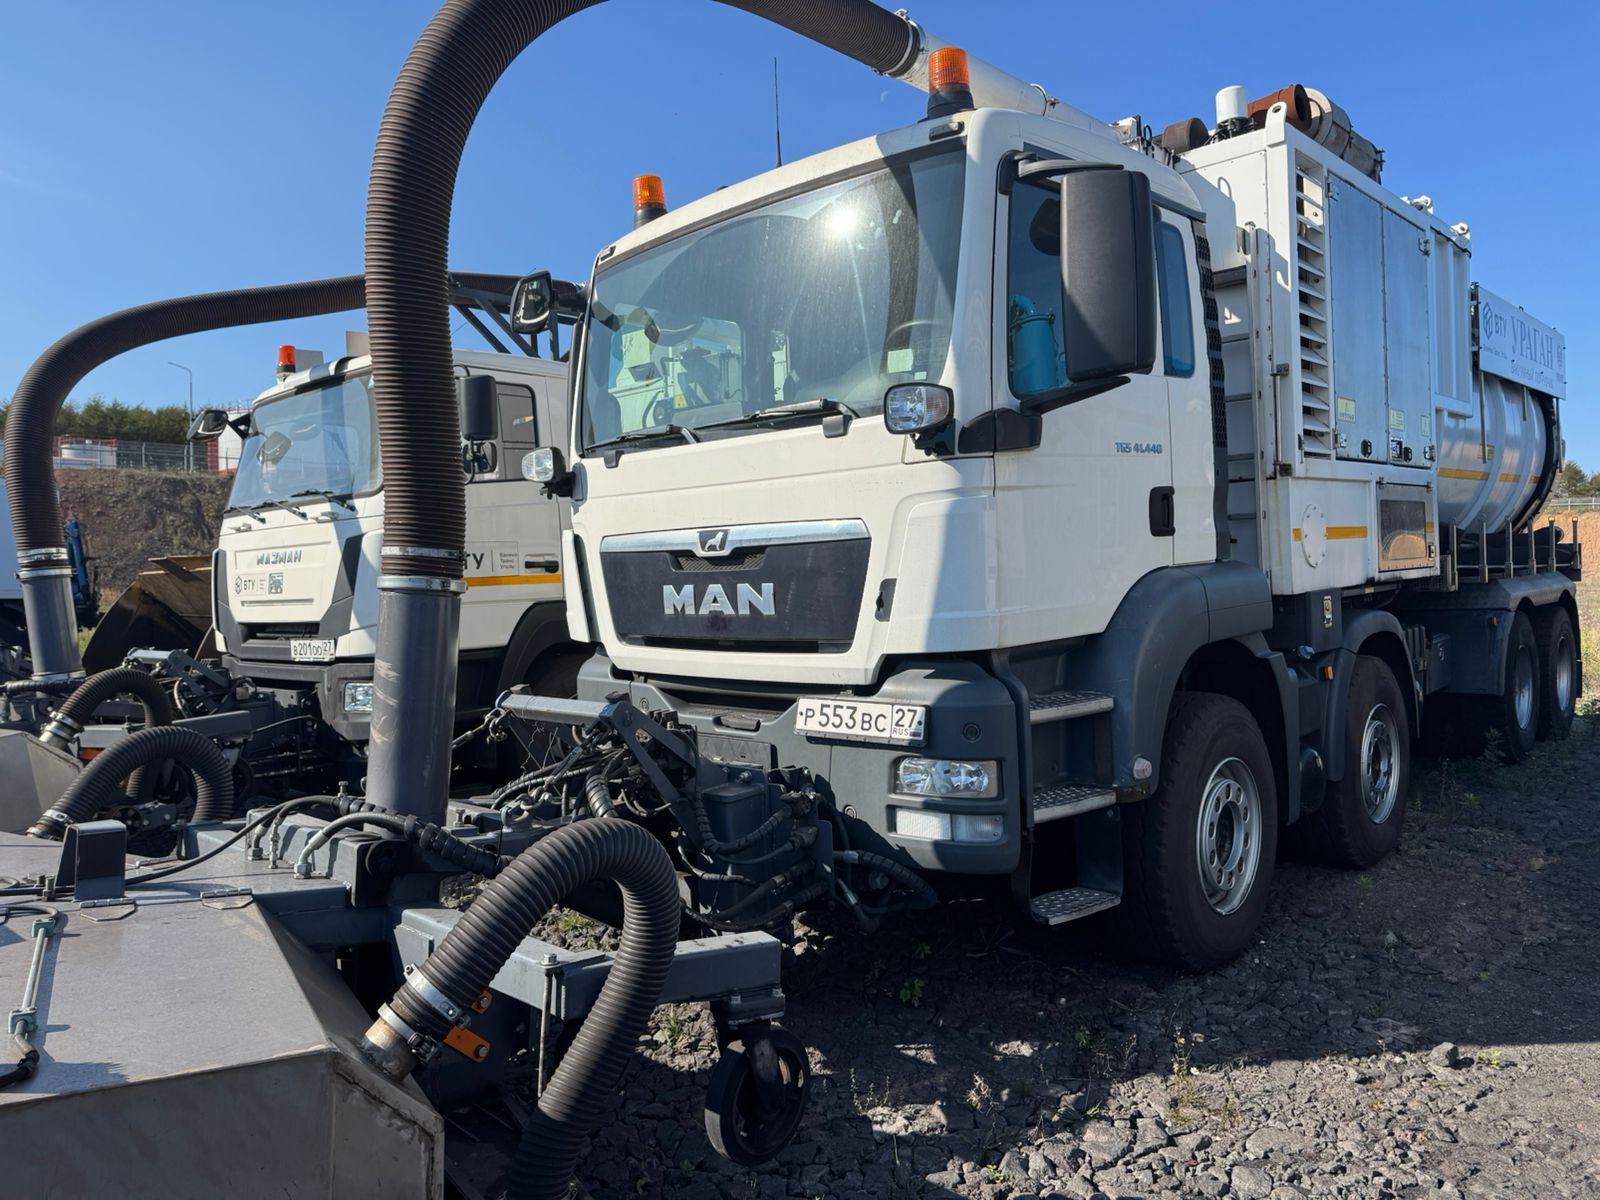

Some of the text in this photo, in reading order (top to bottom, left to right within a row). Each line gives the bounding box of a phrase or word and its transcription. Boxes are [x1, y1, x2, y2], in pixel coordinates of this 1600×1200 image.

[1511, 316, 1554, 370] УРАГАН
[1115, 442, 1131, 453] TGS
[662, 582, 776, 616] MAN
[894, 708, 918, 728] 27
[892, 727, 909, 736] RUS
